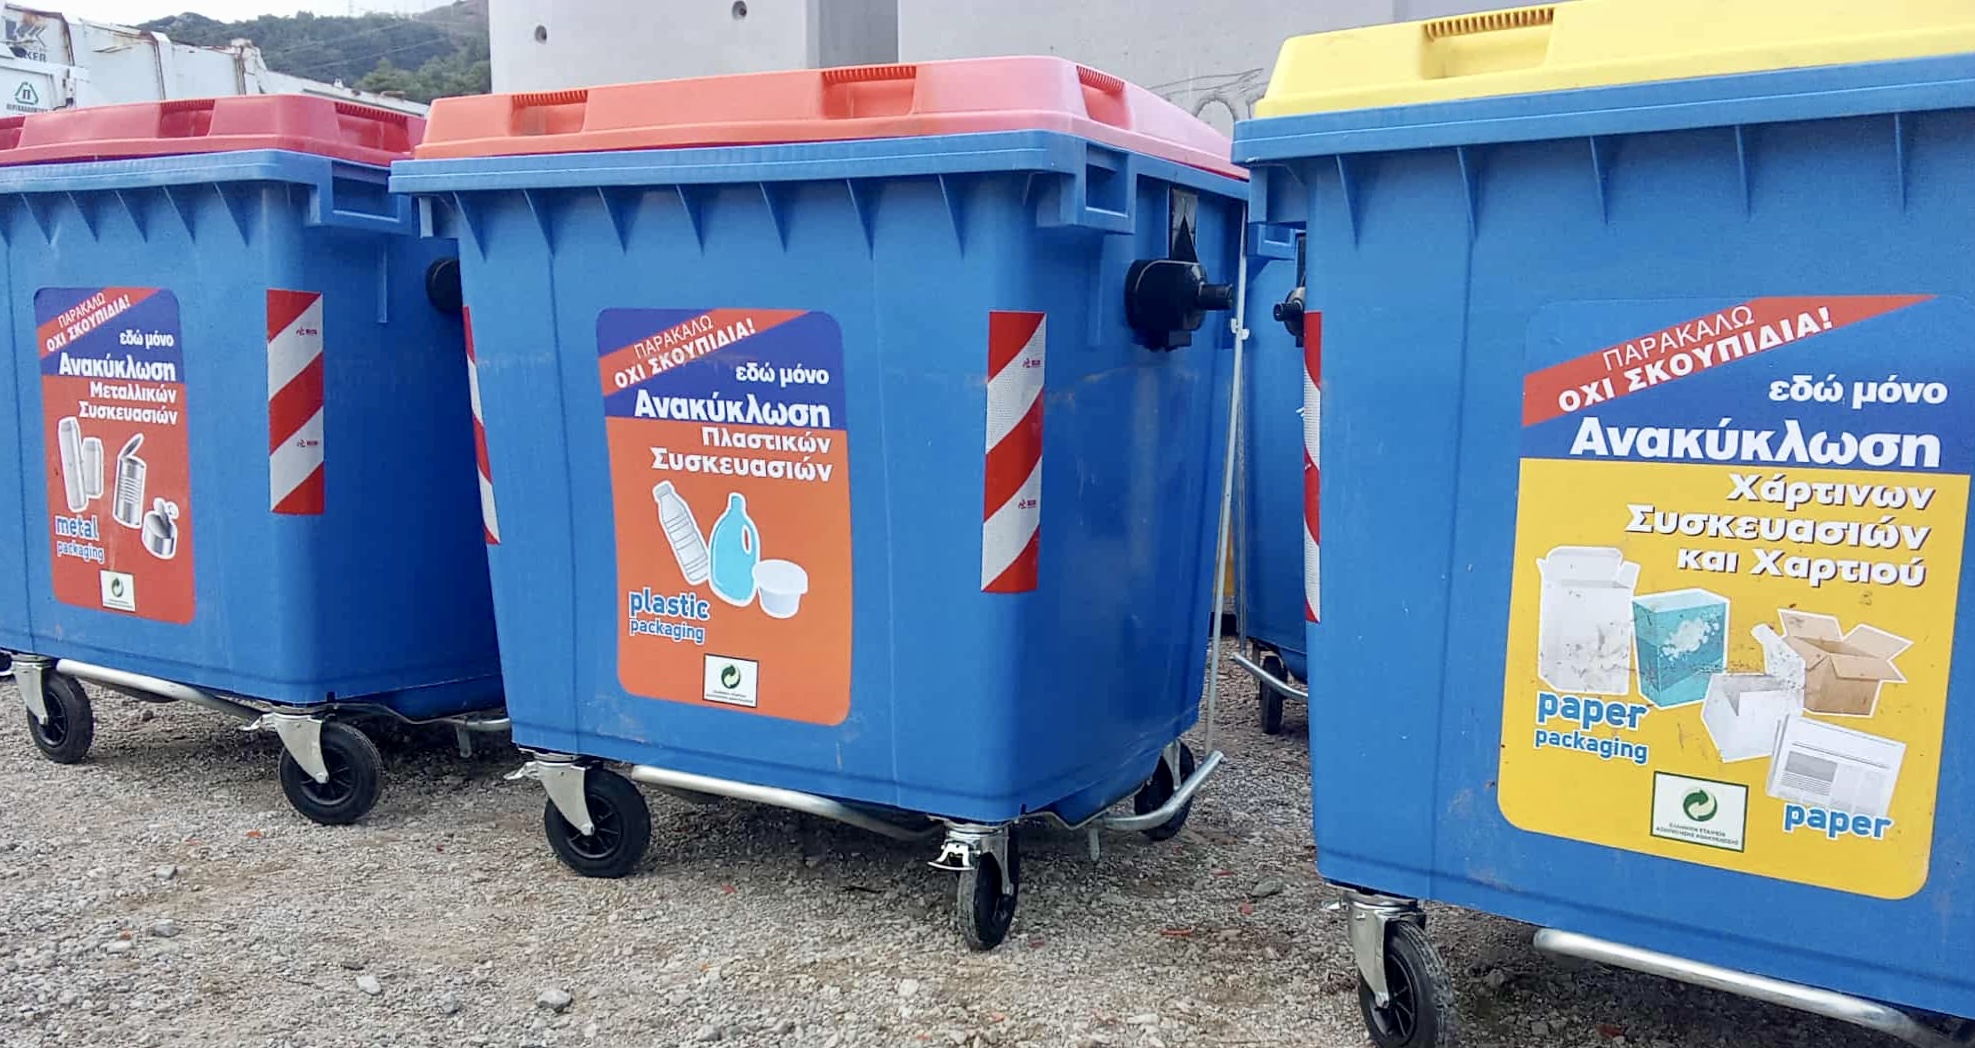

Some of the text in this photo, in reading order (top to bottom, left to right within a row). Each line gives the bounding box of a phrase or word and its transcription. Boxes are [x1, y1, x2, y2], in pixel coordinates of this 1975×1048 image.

[46, 294, 131, 352] ΟΧΙ ΣΚΟΥΠΙΔΙΑ!
[57, 292, 106, 328] ΠΑΡΑΚΑΛΩ
[119, 330, 175, 349] εδώ μόνο
[614, 318, 757, 389] ΟΧΙ ΣΚΟΥΠΙΔΙΑ!
[633, 315, 714, 360] ΠΑΡΑΚΑΛΩ
[1602, 305, 1755, 372] ΠΑΡΑΚΑΛΩ
[58, 352, 176, 381] Ανακύκλωση
[735, 361, 830, 388] εδώ μόνο
[1557, 306, 1834, 413] ΟΧΙ ΣΚΟΥΠΙΔΙΑ!
[90, 381, 177, 403] Μεταλλικών
[633, 388, 831, 428] Ανακύκλωση
[1768, 373, 1948, 409] εδώ μόνο
[78, 401, 178, 424] Συσκευασιών
[701, 426, 832, 454] Πλαστικών
[1569, 416, 1941, 468] Ανακύκλωση
[649, 446, 834, 482] Συσκευασιών
[1726, 472, 1936, 511] Χάρτινων
[56, 515, 99, 541] metal
[1623, 503, 1931, 551] Συσκευασιών
[56, 541, 104, 564] packaging
[1677, 547, 1928, 589] και Χαρτιού
[629, 588, 709, 620] plastic
[629, 618, 705, 644] packaging
[1537, 691, 1648, 730] paper
[1534, 730, 1649, 765] packaging
[1785, 803, 1893, 840] paper
